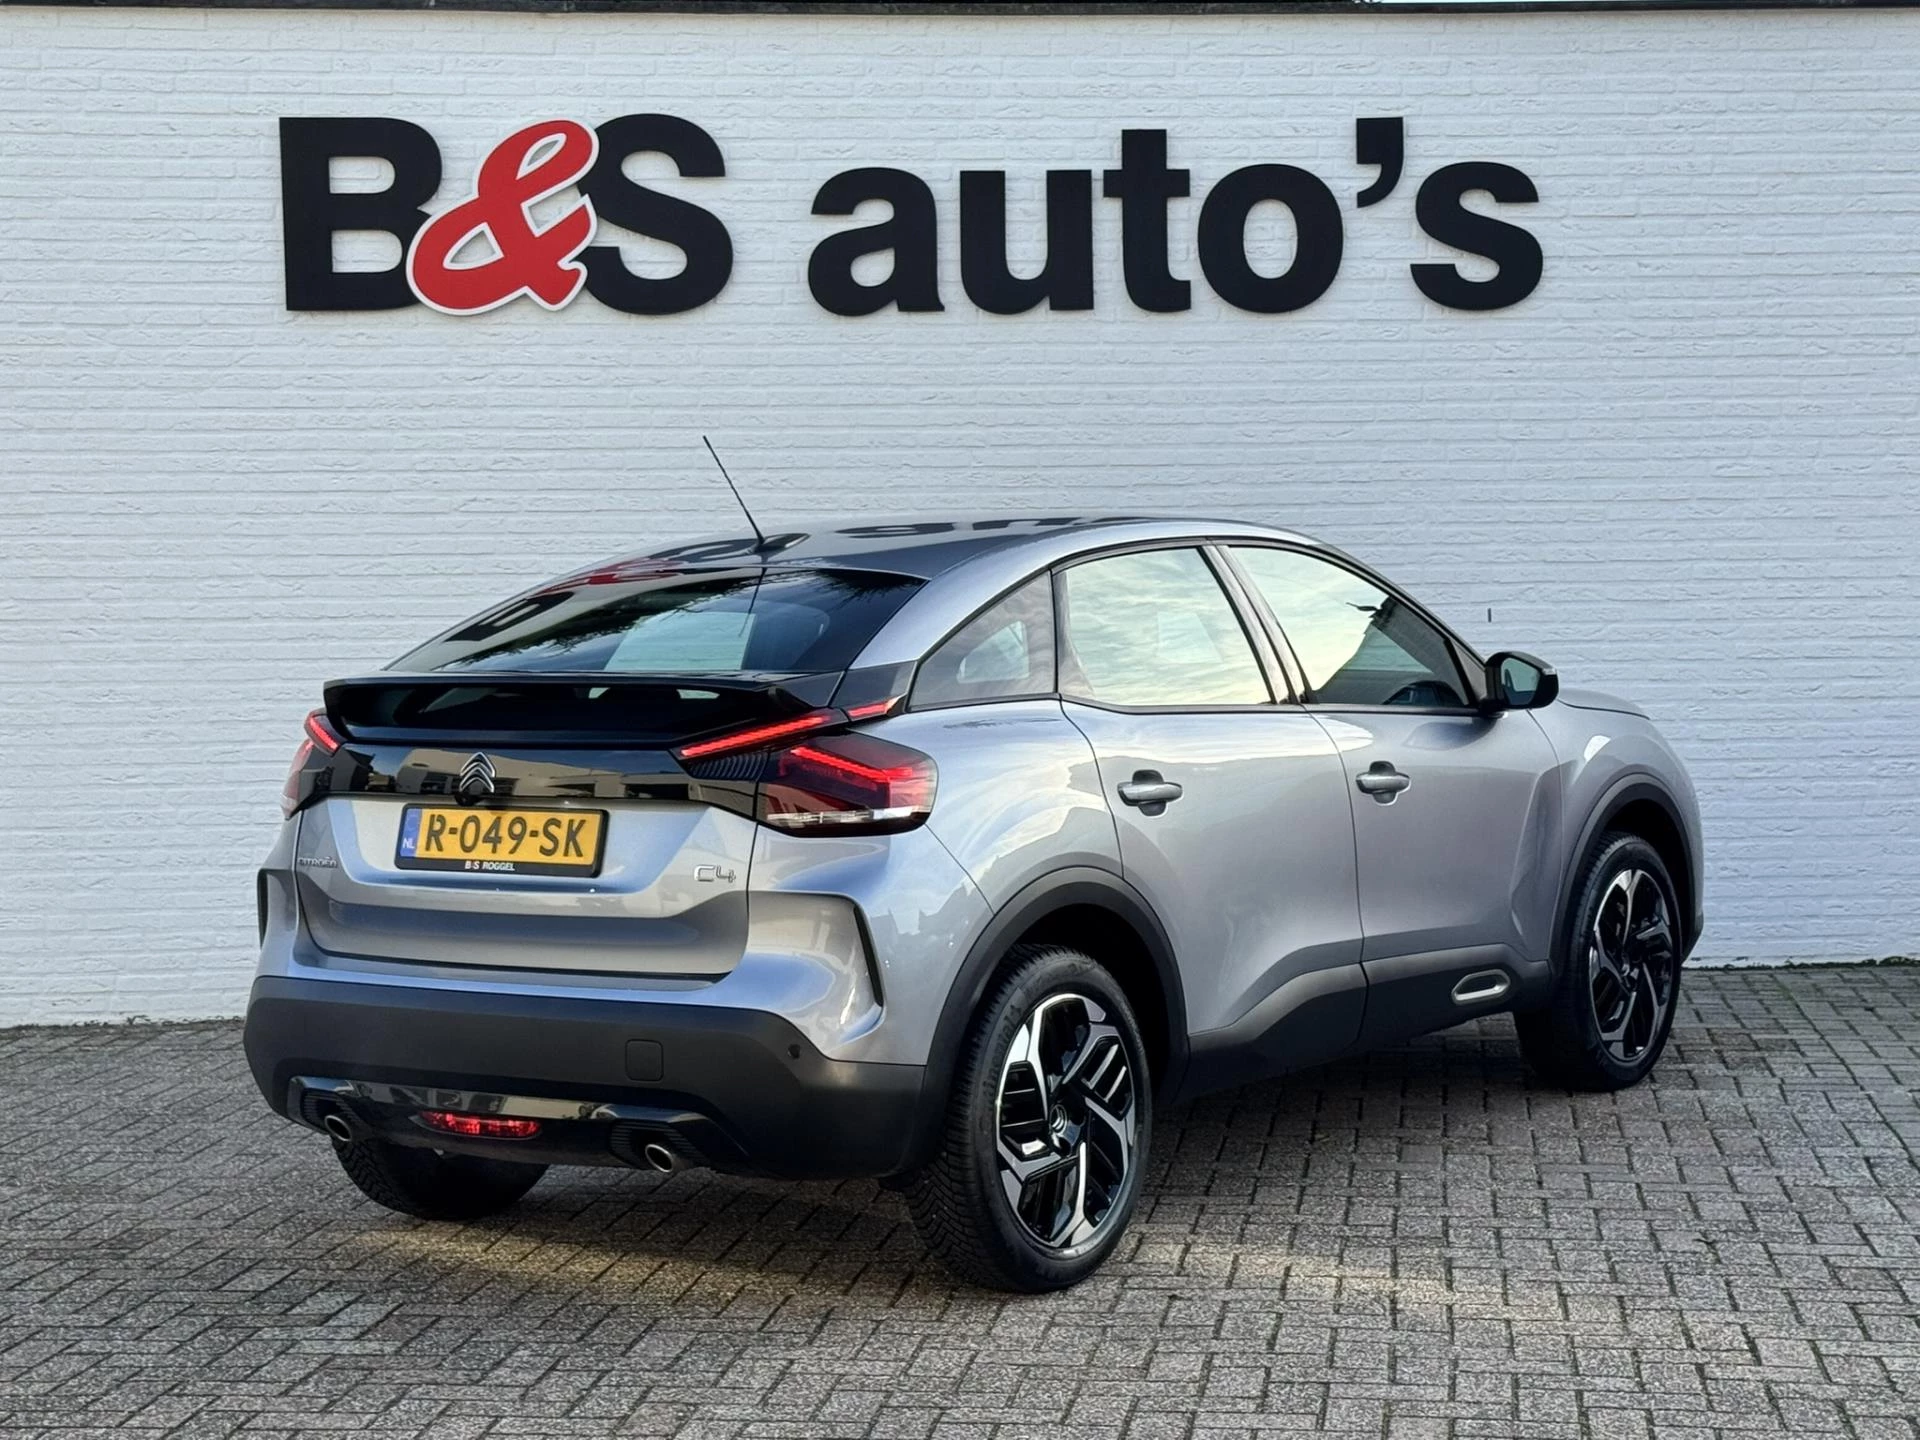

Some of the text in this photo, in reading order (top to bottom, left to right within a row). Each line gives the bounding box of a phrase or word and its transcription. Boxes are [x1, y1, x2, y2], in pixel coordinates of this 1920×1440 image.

[279, 113, 1544, 316] B&S auto's
[402, 838, 415, 850] NL
[425, 814, 587, 858] R-049-SK
[482, 861, 516, 872] ROGGEL
[693, 864, 737, 883] C4
